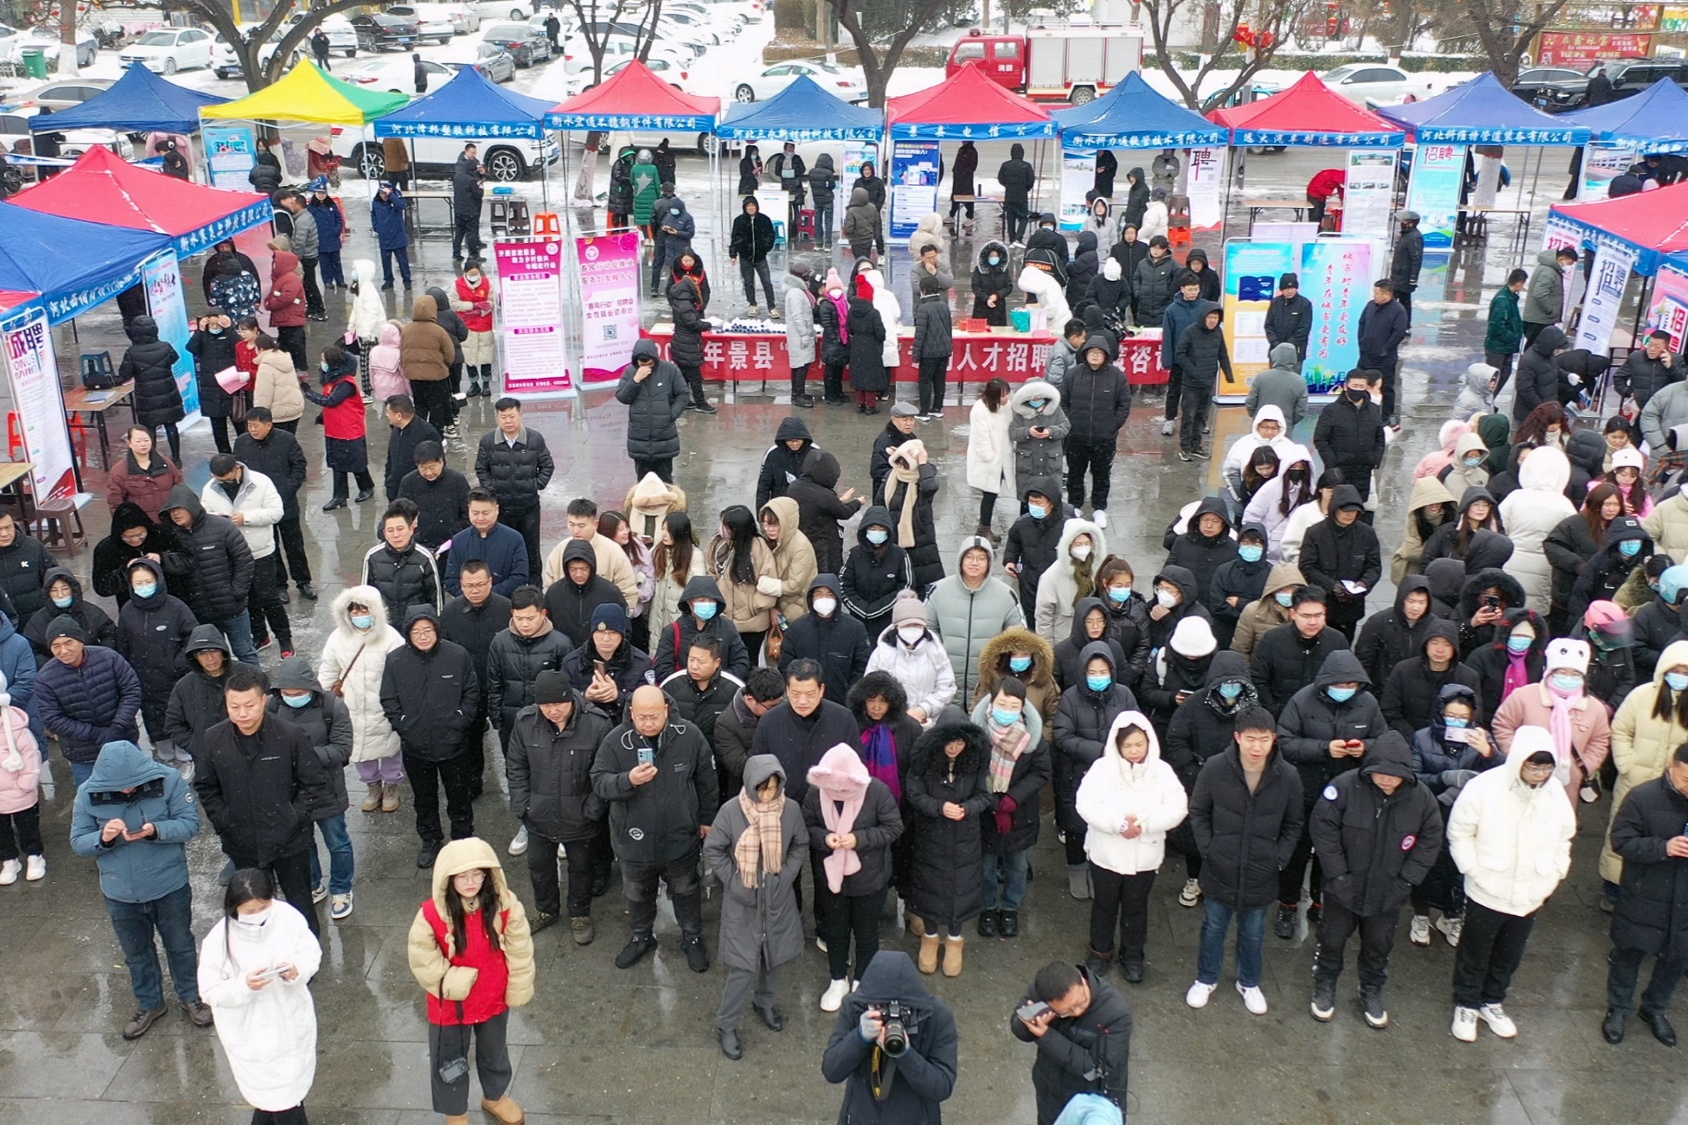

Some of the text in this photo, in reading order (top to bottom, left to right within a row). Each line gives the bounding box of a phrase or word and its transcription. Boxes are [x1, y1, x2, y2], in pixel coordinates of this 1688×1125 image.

[907, 123, 1053, 138] 景县电信公司
[1424, 145, 1465, 165] 招聘
[1336, 252, 1353, 346] 城市对青年更友好
